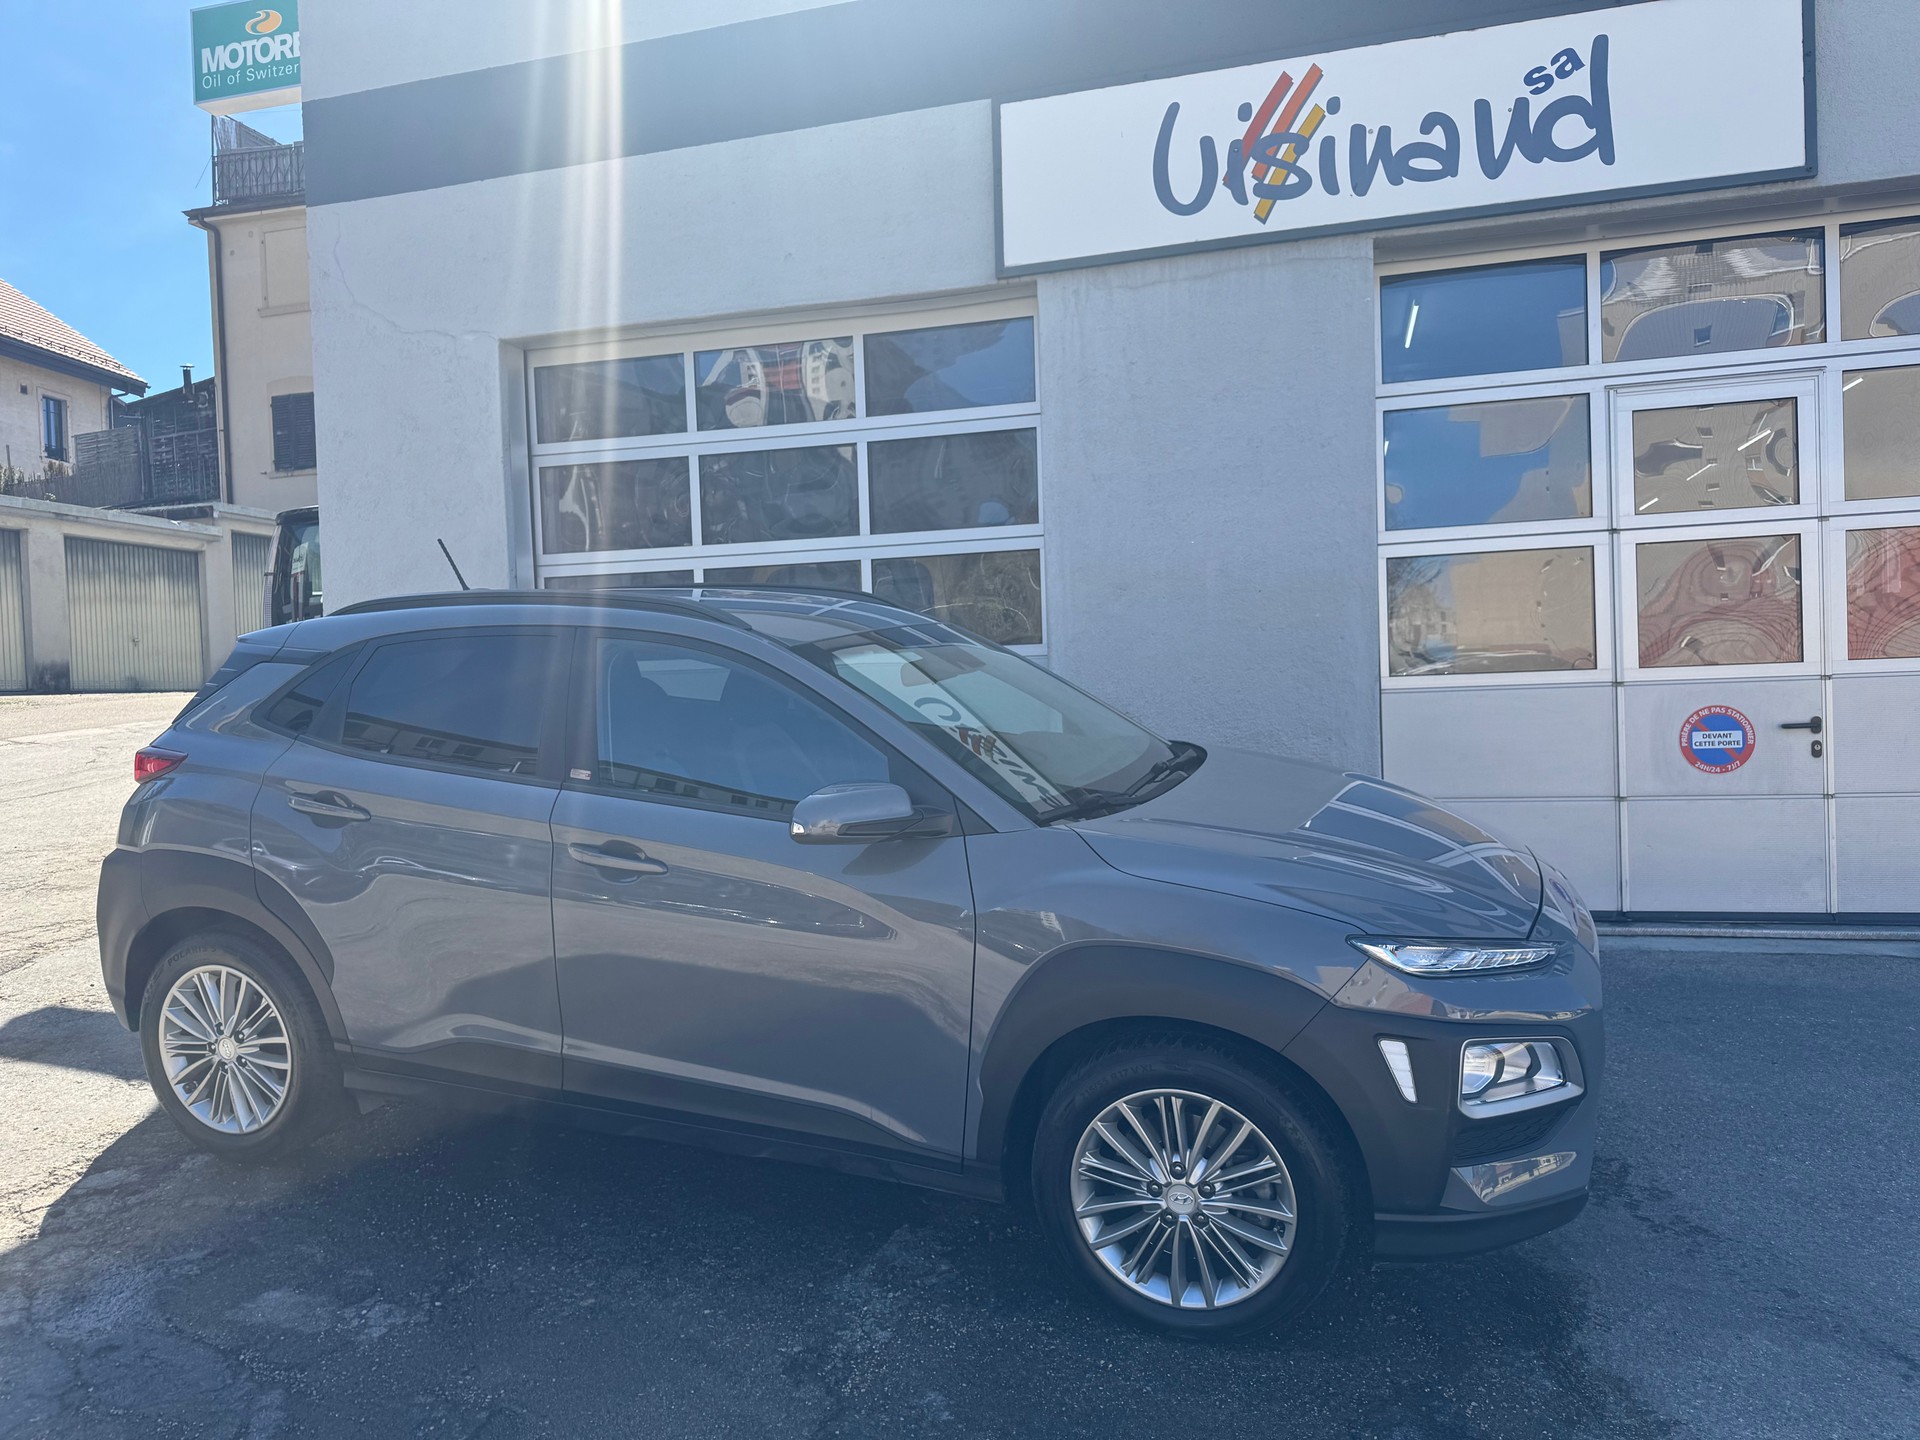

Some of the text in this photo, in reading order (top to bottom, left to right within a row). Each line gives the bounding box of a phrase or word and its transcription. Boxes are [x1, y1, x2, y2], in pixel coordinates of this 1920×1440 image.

[202, 63, 299, 89] Oil of Switzer
[1523, 47, 1586, 96] sa
[1689, 713, 1700, 724] DE
[1699, 708, 1710, 717] NE
[1727, 708, 1754, 745] STATIONNER
[1695, 761, 1721, 773] 24H/24
